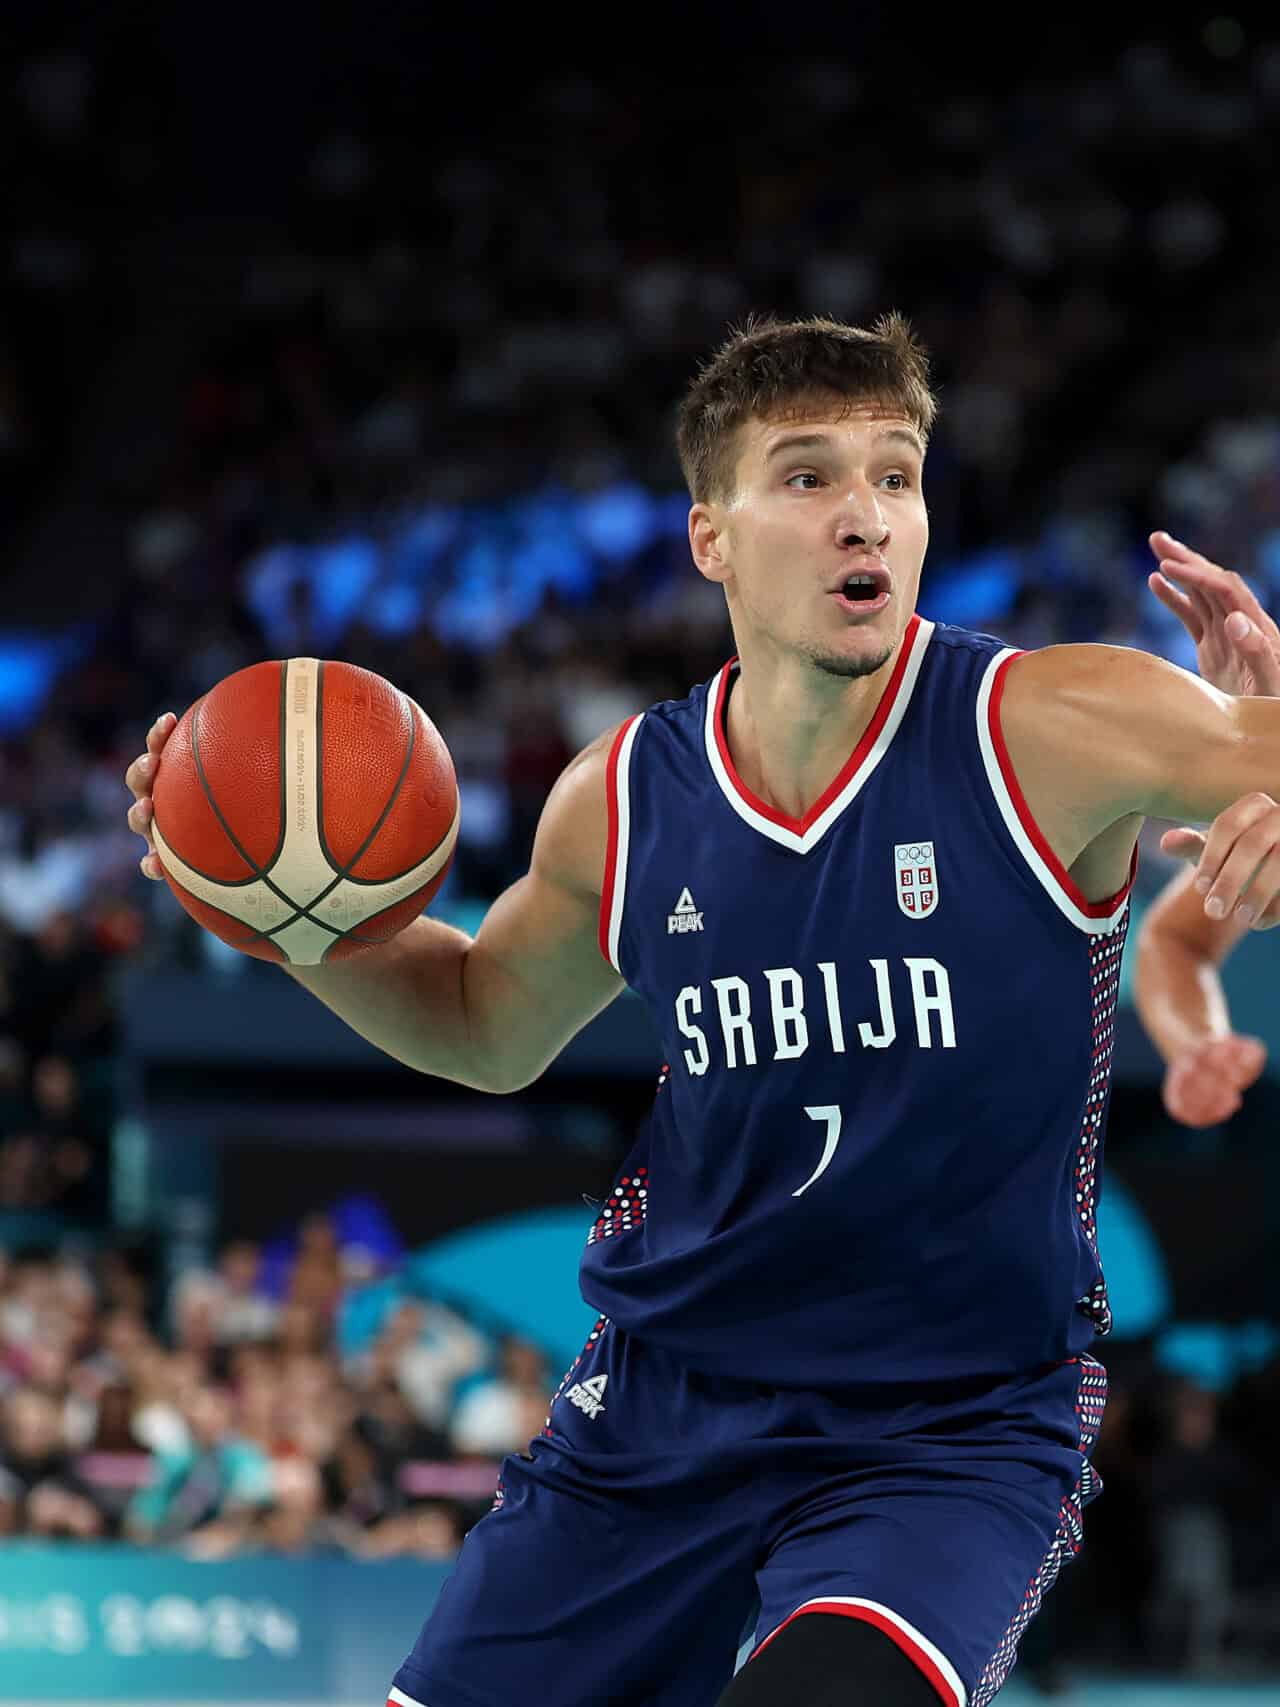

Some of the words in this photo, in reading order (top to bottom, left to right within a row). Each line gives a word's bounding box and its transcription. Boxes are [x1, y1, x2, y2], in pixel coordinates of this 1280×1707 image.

[667, 911, 704, 935] PEAK
[674, 957, 957, 1076] SRBIJA
[791, 1104, 842, 1197] 7
[564, 1383, 606, 1420] PEAK
